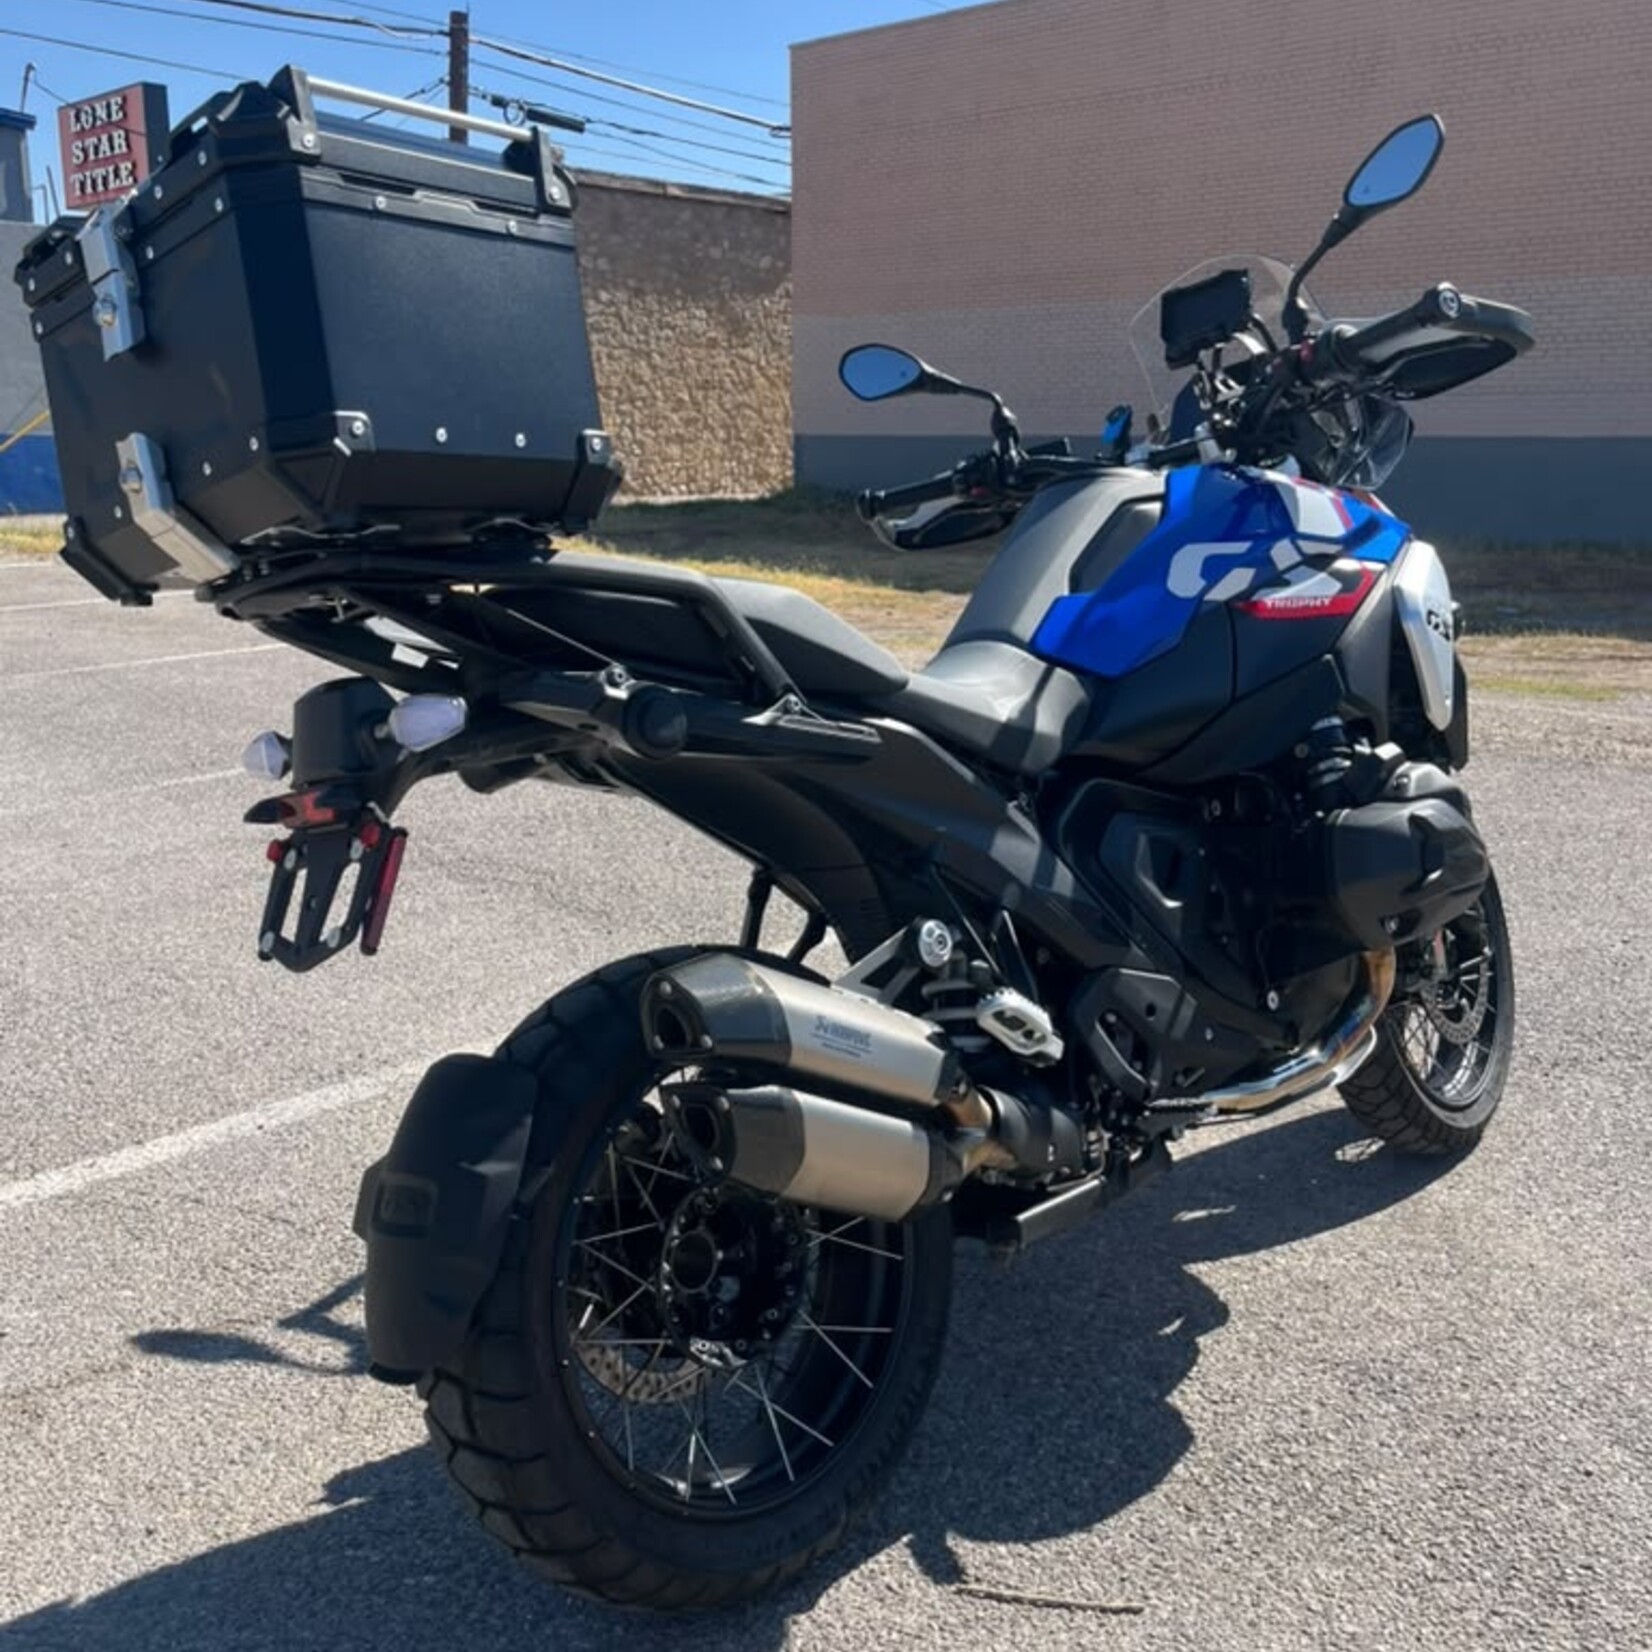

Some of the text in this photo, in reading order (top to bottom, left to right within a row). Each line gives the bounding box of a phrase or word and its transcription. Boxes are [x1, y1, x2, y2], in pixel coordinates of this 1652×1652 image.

[69, 96, 124, 132] LONE
[71, 129, 129, 165] STAR
[70, 161, 136, 197] TITLE
[1166, 537, 1344, 601] GS
